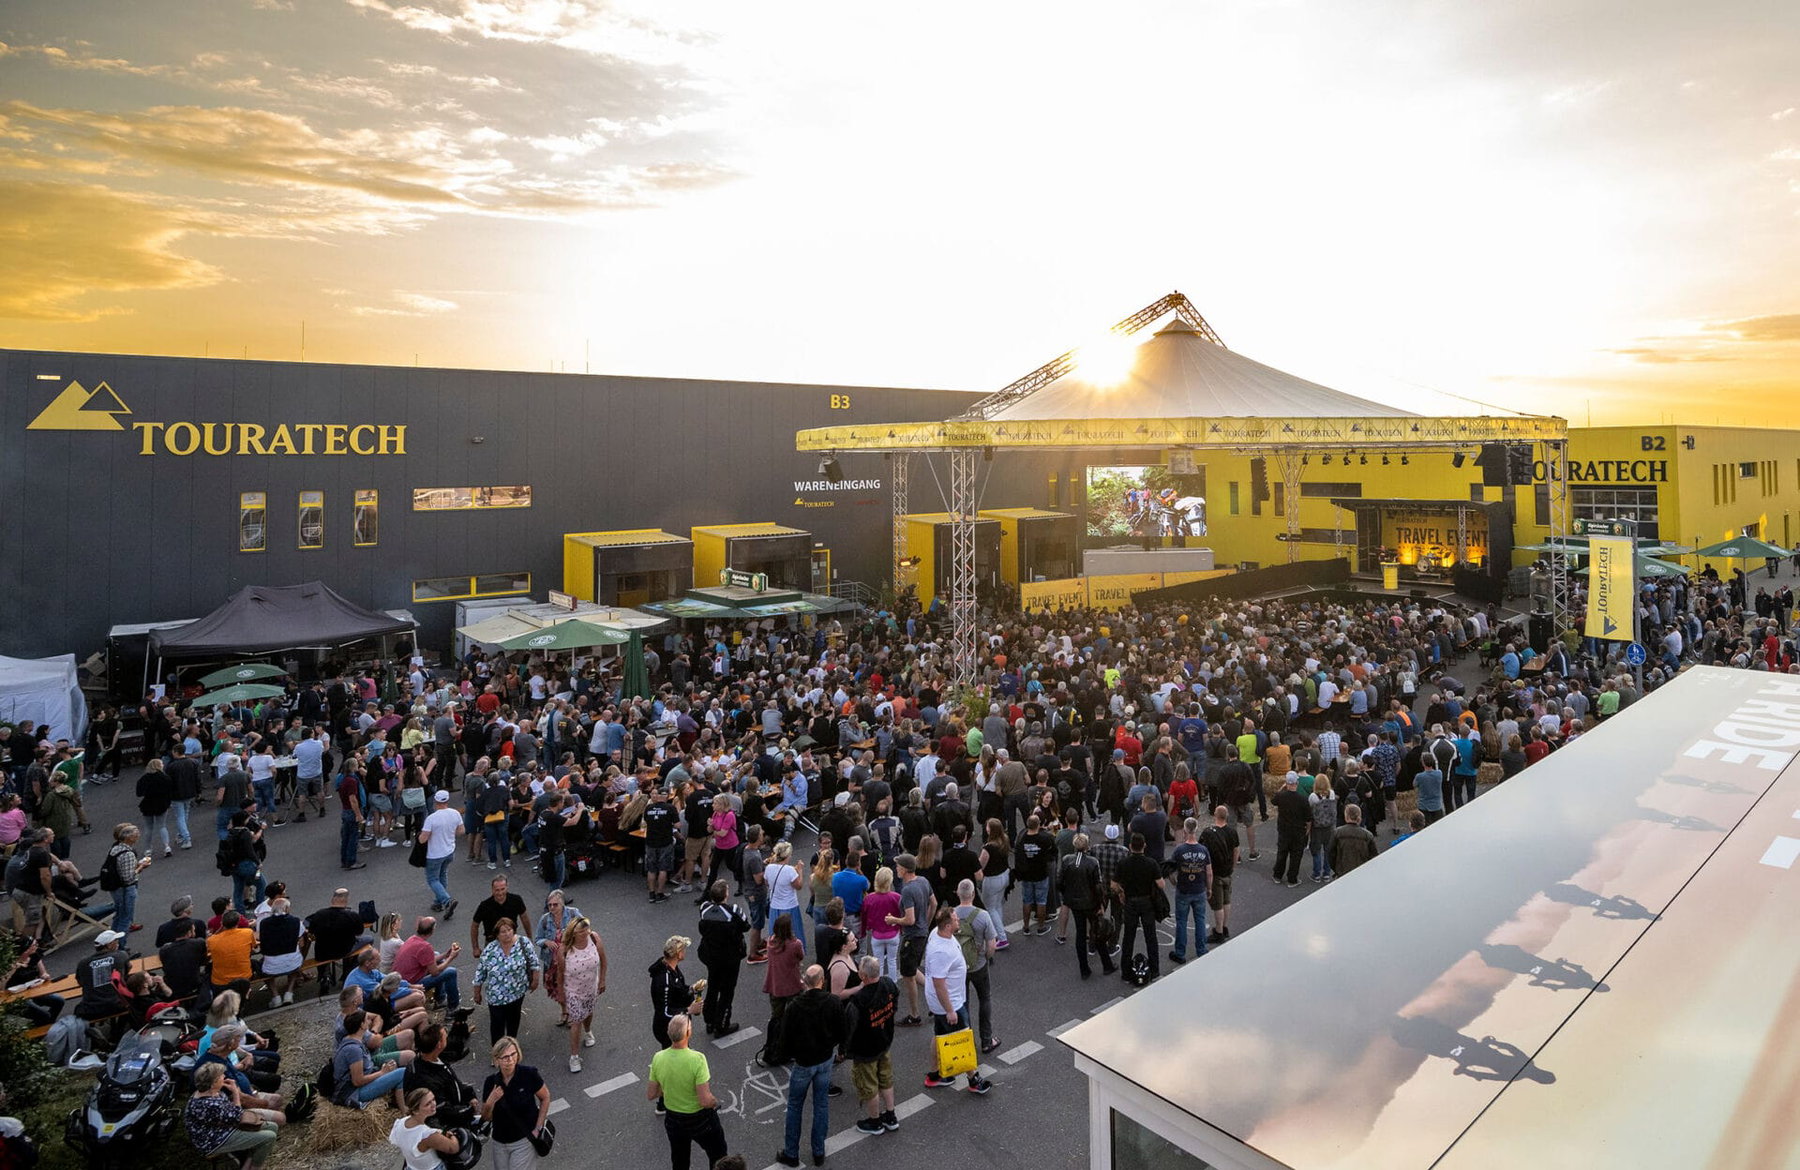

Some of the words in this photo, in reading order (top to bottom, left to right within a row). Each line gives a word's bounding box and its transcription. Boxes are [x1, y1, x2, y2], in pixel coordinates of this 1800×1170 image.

[830, 393, 851, 409] B3
[132, 421, 407, 456] TOURATECH
[1641, 436, 1666, 451] B2
[1532, 460, 1669, 482] OURATECH
[794, 479, 881, 492] WARENEINGANG
[1396, 527, 1443, 545] TRAVEL
[1026, 594, 1057, 608] TRAVEL
[1058, 591, 1084, 604] EVENT
[1094, 587, 1128, 600] TRAVEL
